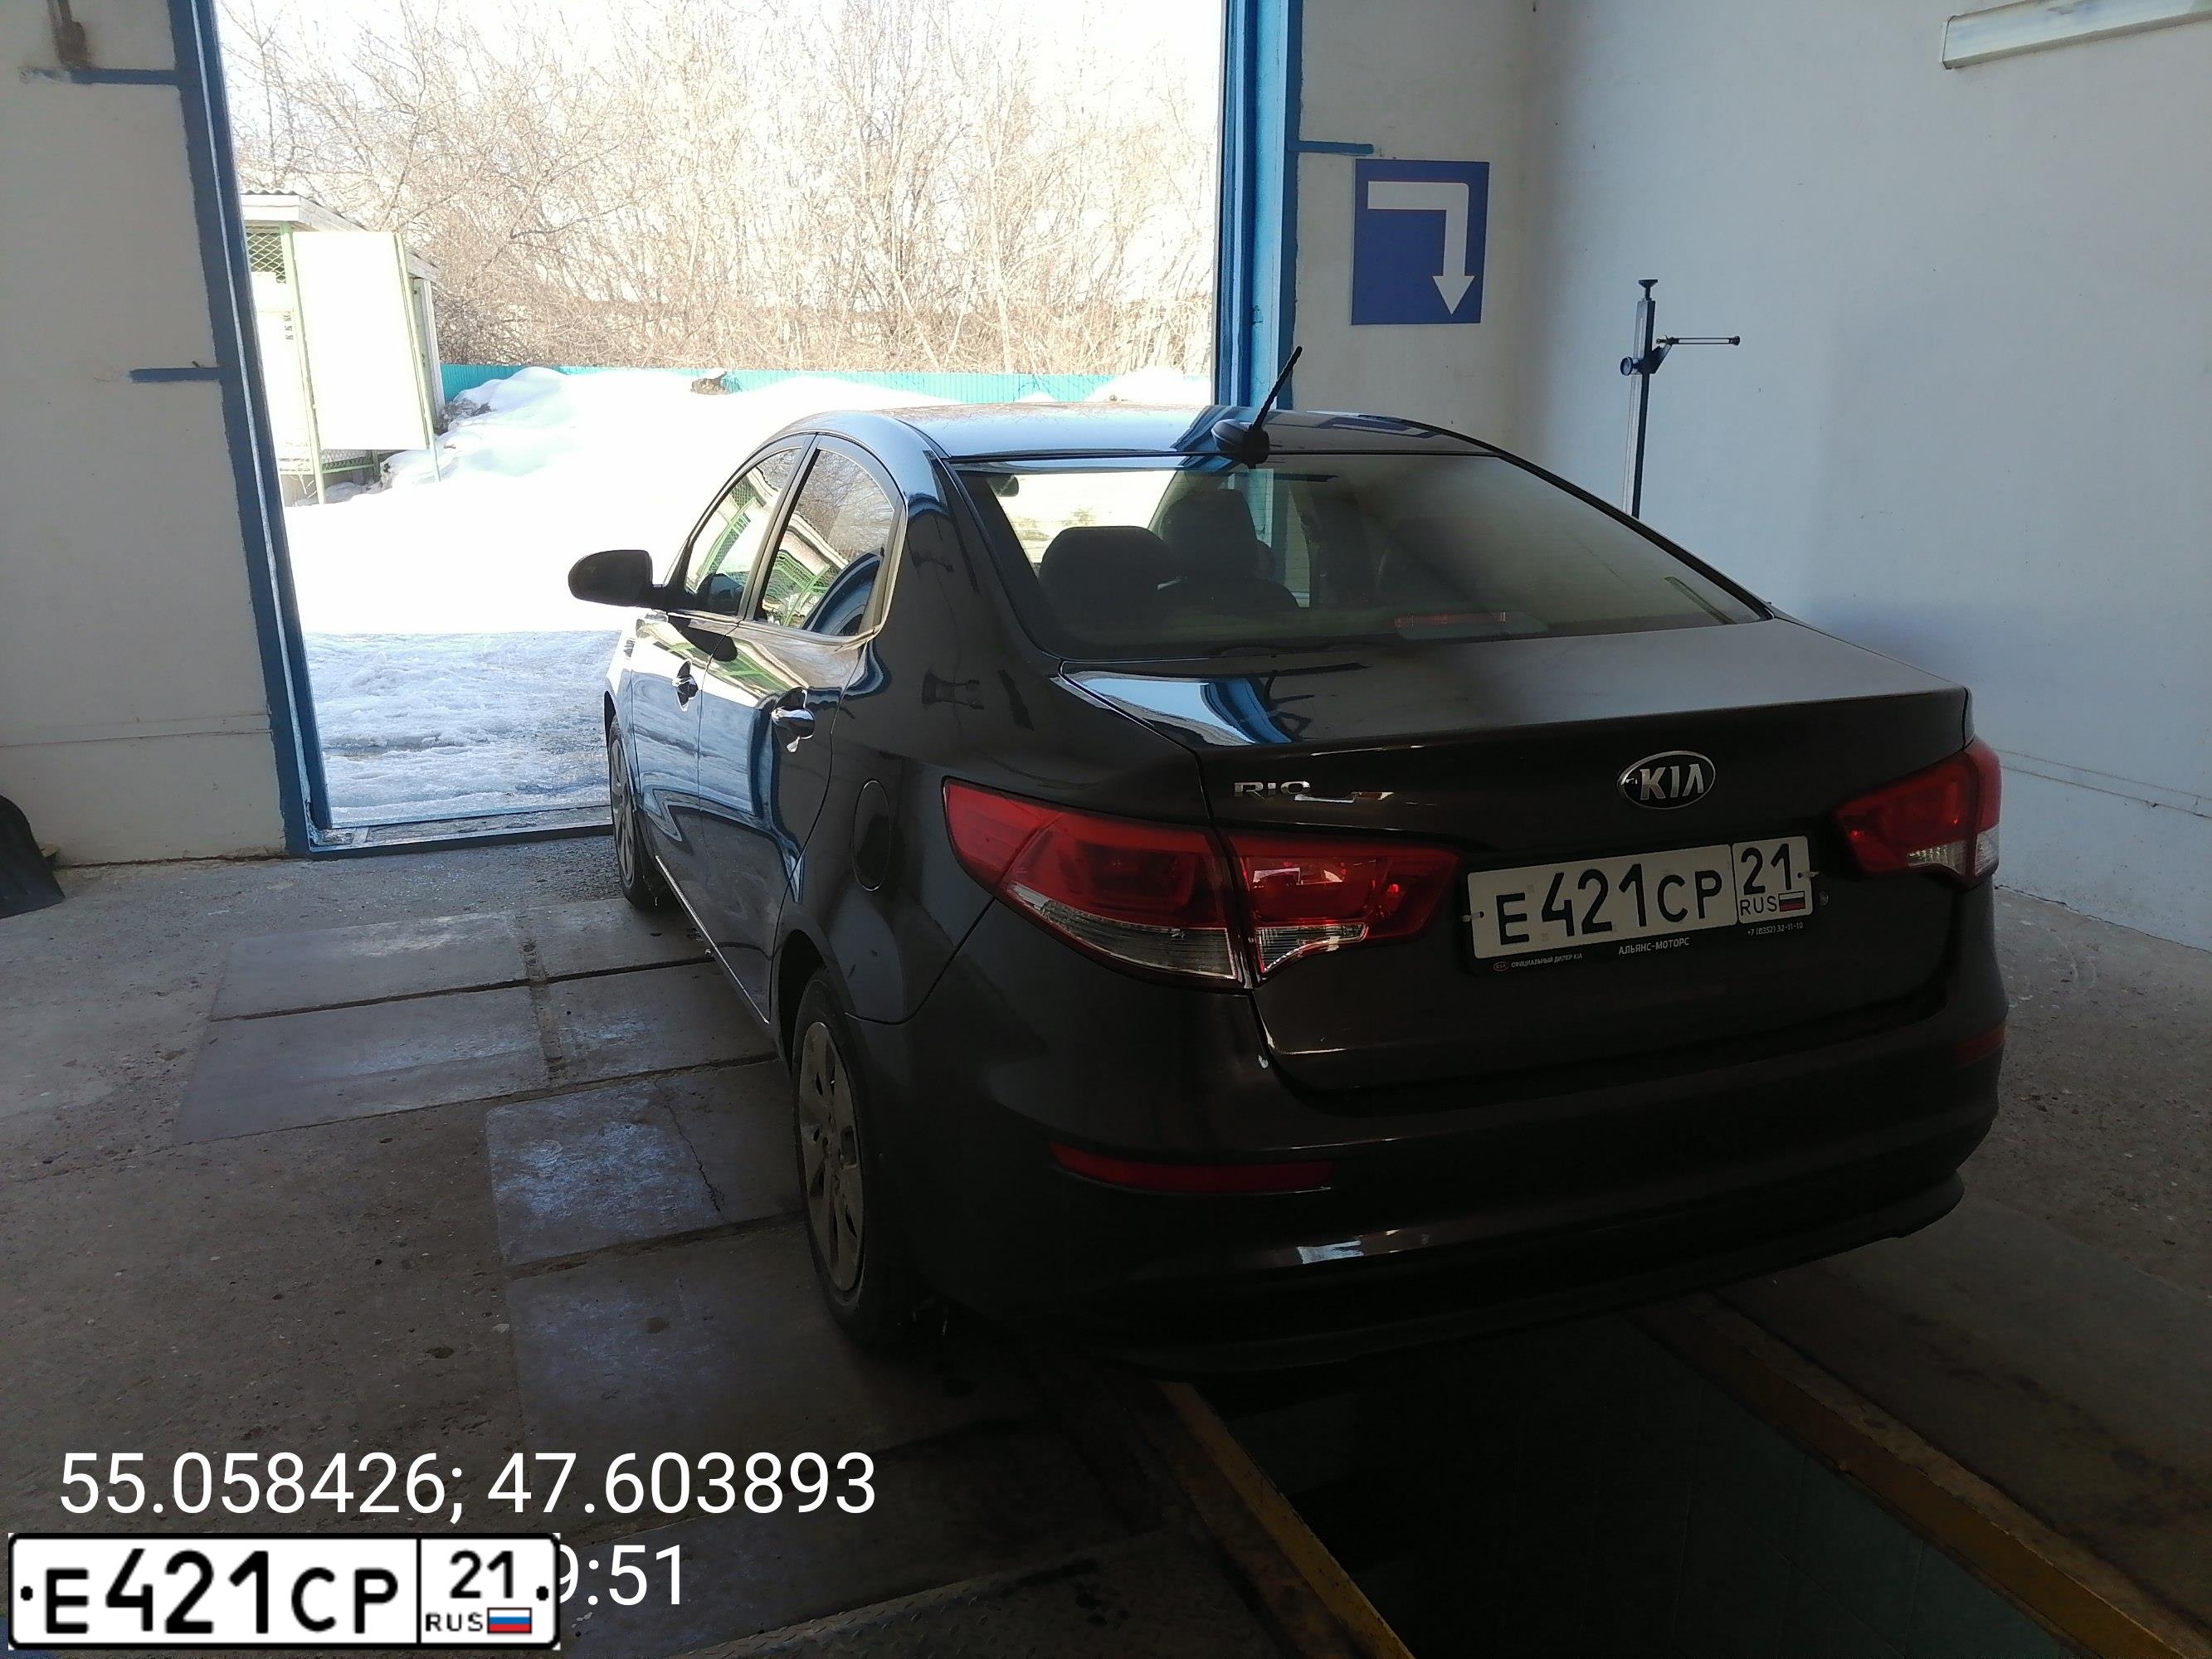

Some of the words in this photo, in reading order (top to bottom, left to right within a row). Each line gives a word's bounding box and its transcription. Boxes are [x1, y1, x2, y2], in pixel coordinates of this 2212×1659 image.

[1640, 763, 1704, 800] KIA
[1739, 843, 1792, 895] 21
[1739, 895, 1778, 916] RUS
[1618, 937, 1690, 955] АЛЬЯНС-МОТОРС
